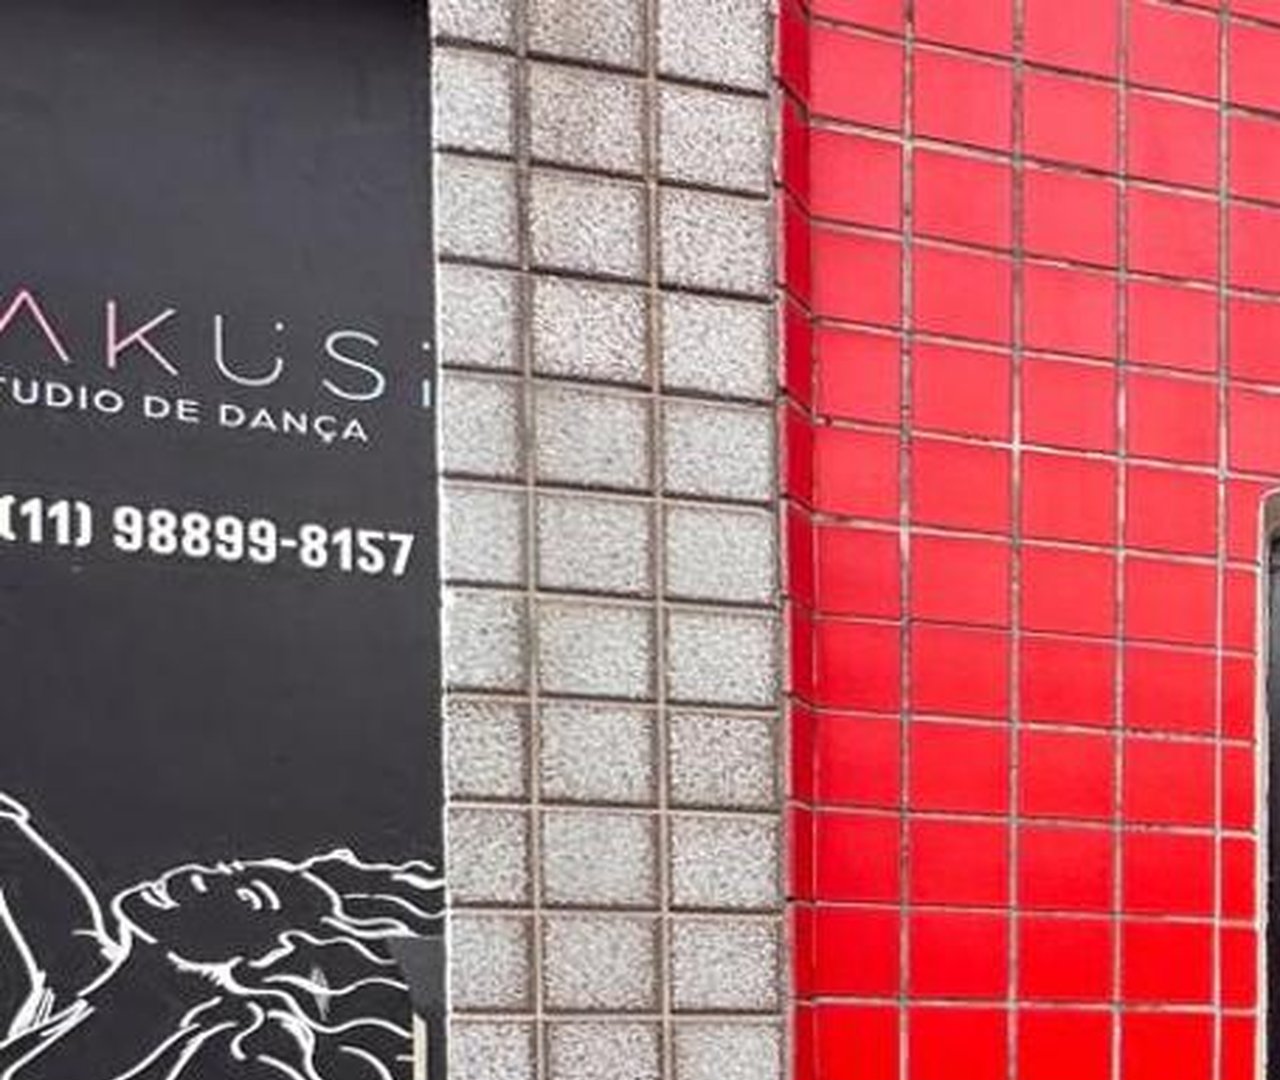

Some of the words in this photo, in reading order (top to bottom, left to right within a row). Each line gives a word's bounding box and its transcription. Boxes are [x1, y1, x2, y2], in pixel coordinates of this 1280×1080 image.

[0, 376, 124, 413] UDIO
[143, 395, 201, 424] DE
[219, 404, 369, 443] DANÇA
[0, 494, 92, 547] (11)
[112, 505, 415, 576] 98899-8157
